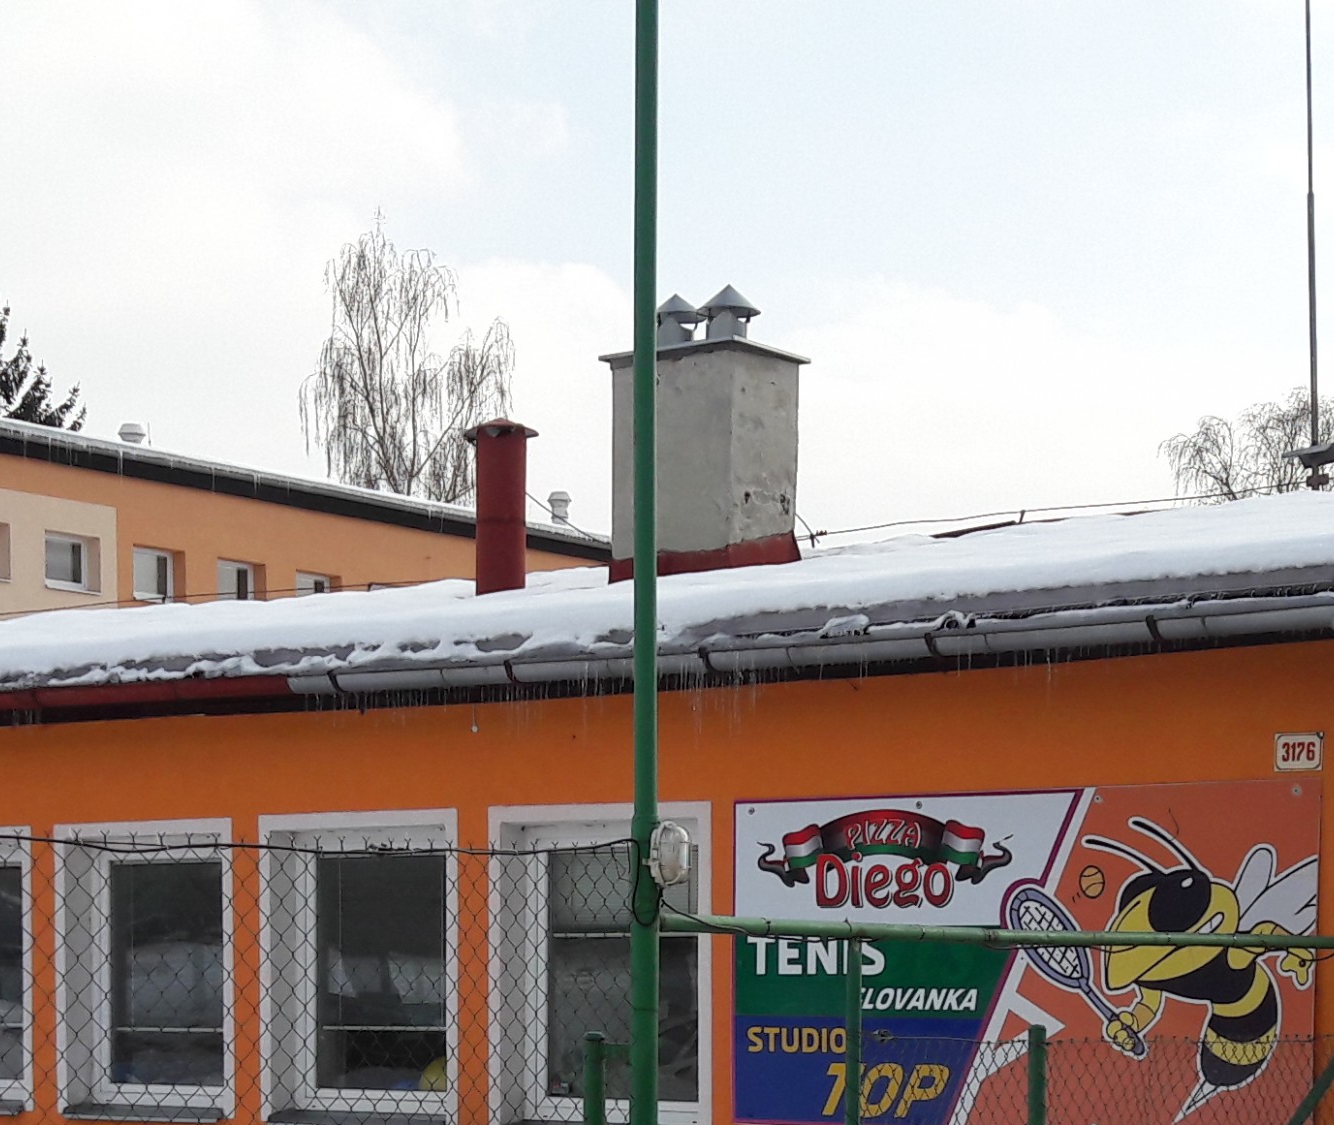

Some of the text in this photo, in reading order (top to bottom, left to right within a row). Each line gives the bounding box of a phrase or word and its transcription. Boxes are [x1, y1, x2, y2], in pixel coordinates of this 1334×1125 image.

[1282, 741, 1316, 762] 3176
[844, 819, 922, 849] PIZZA
[816, 852, 954, 908] Diego
[746, 1026, 848, 1054] STUDIO
[821, 1062, 951, 1119] TOP
